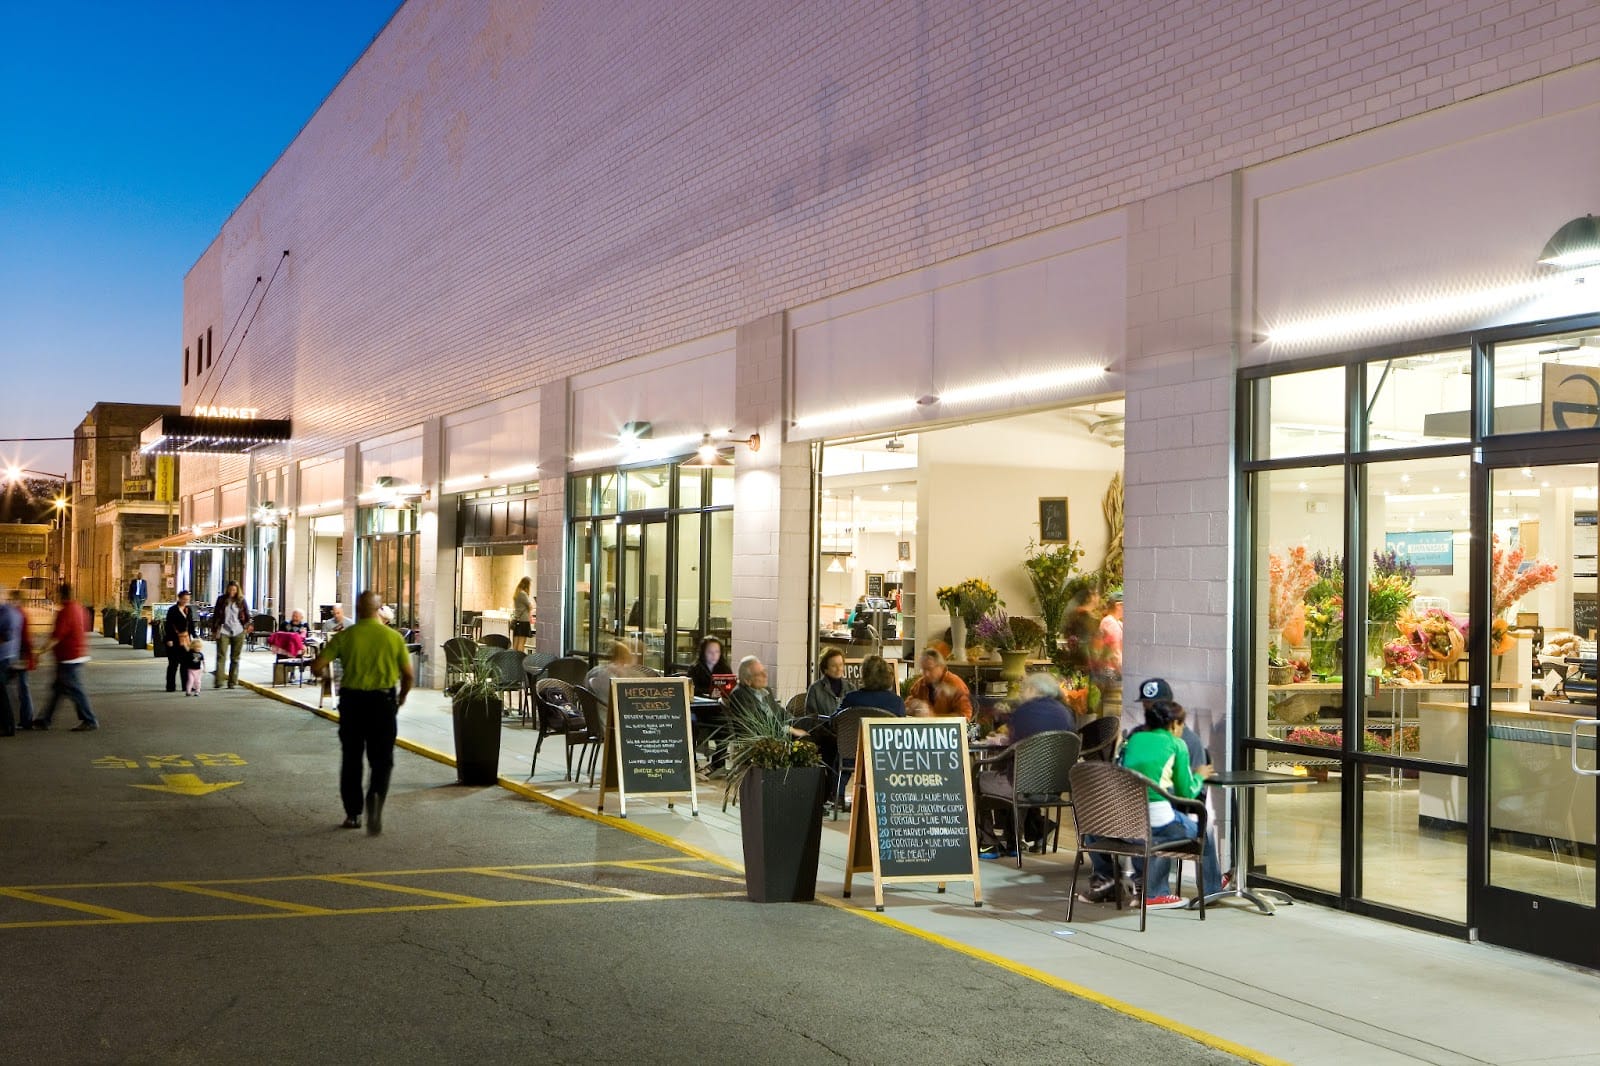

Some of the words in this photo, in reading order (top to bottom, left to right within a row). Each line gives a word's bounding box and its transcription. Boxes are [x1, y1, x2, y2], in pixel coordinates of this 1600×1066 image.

[195, 406, 258, 419] MARKET
[624, 688, 676, 697] HERITAGE
[632, 702, 671, 710] TURKEYS
[872, 728, 958, 750] UPCOMING
[874, 751, 959, 771] EVENTS
[889, 773, 944, 787] OCTOBER
[876, 792, 886, 803] 12
[890, 793, 924, 802] COCKTAILS
[942, 792, 961, 801] MUSIC
[877, 805, 886, 814] 13
[890, 804, 915, 813] OYSTER
[878, 817, 887, 825] 19
[941, 815, 961, 824] MUSIC
[879, 828, 890, 838] 20
[890, 828, 903, 837] THE
[880, 839, 891, 849] 26
[890, 838, 924, 848] COCKTAILS
[942, 838, 961, 848] MUSIC
[880, 849, 892, 860] 27
[893, 849, 906, 859] THE
[907, 849, 937, 859] MEAT-UP
